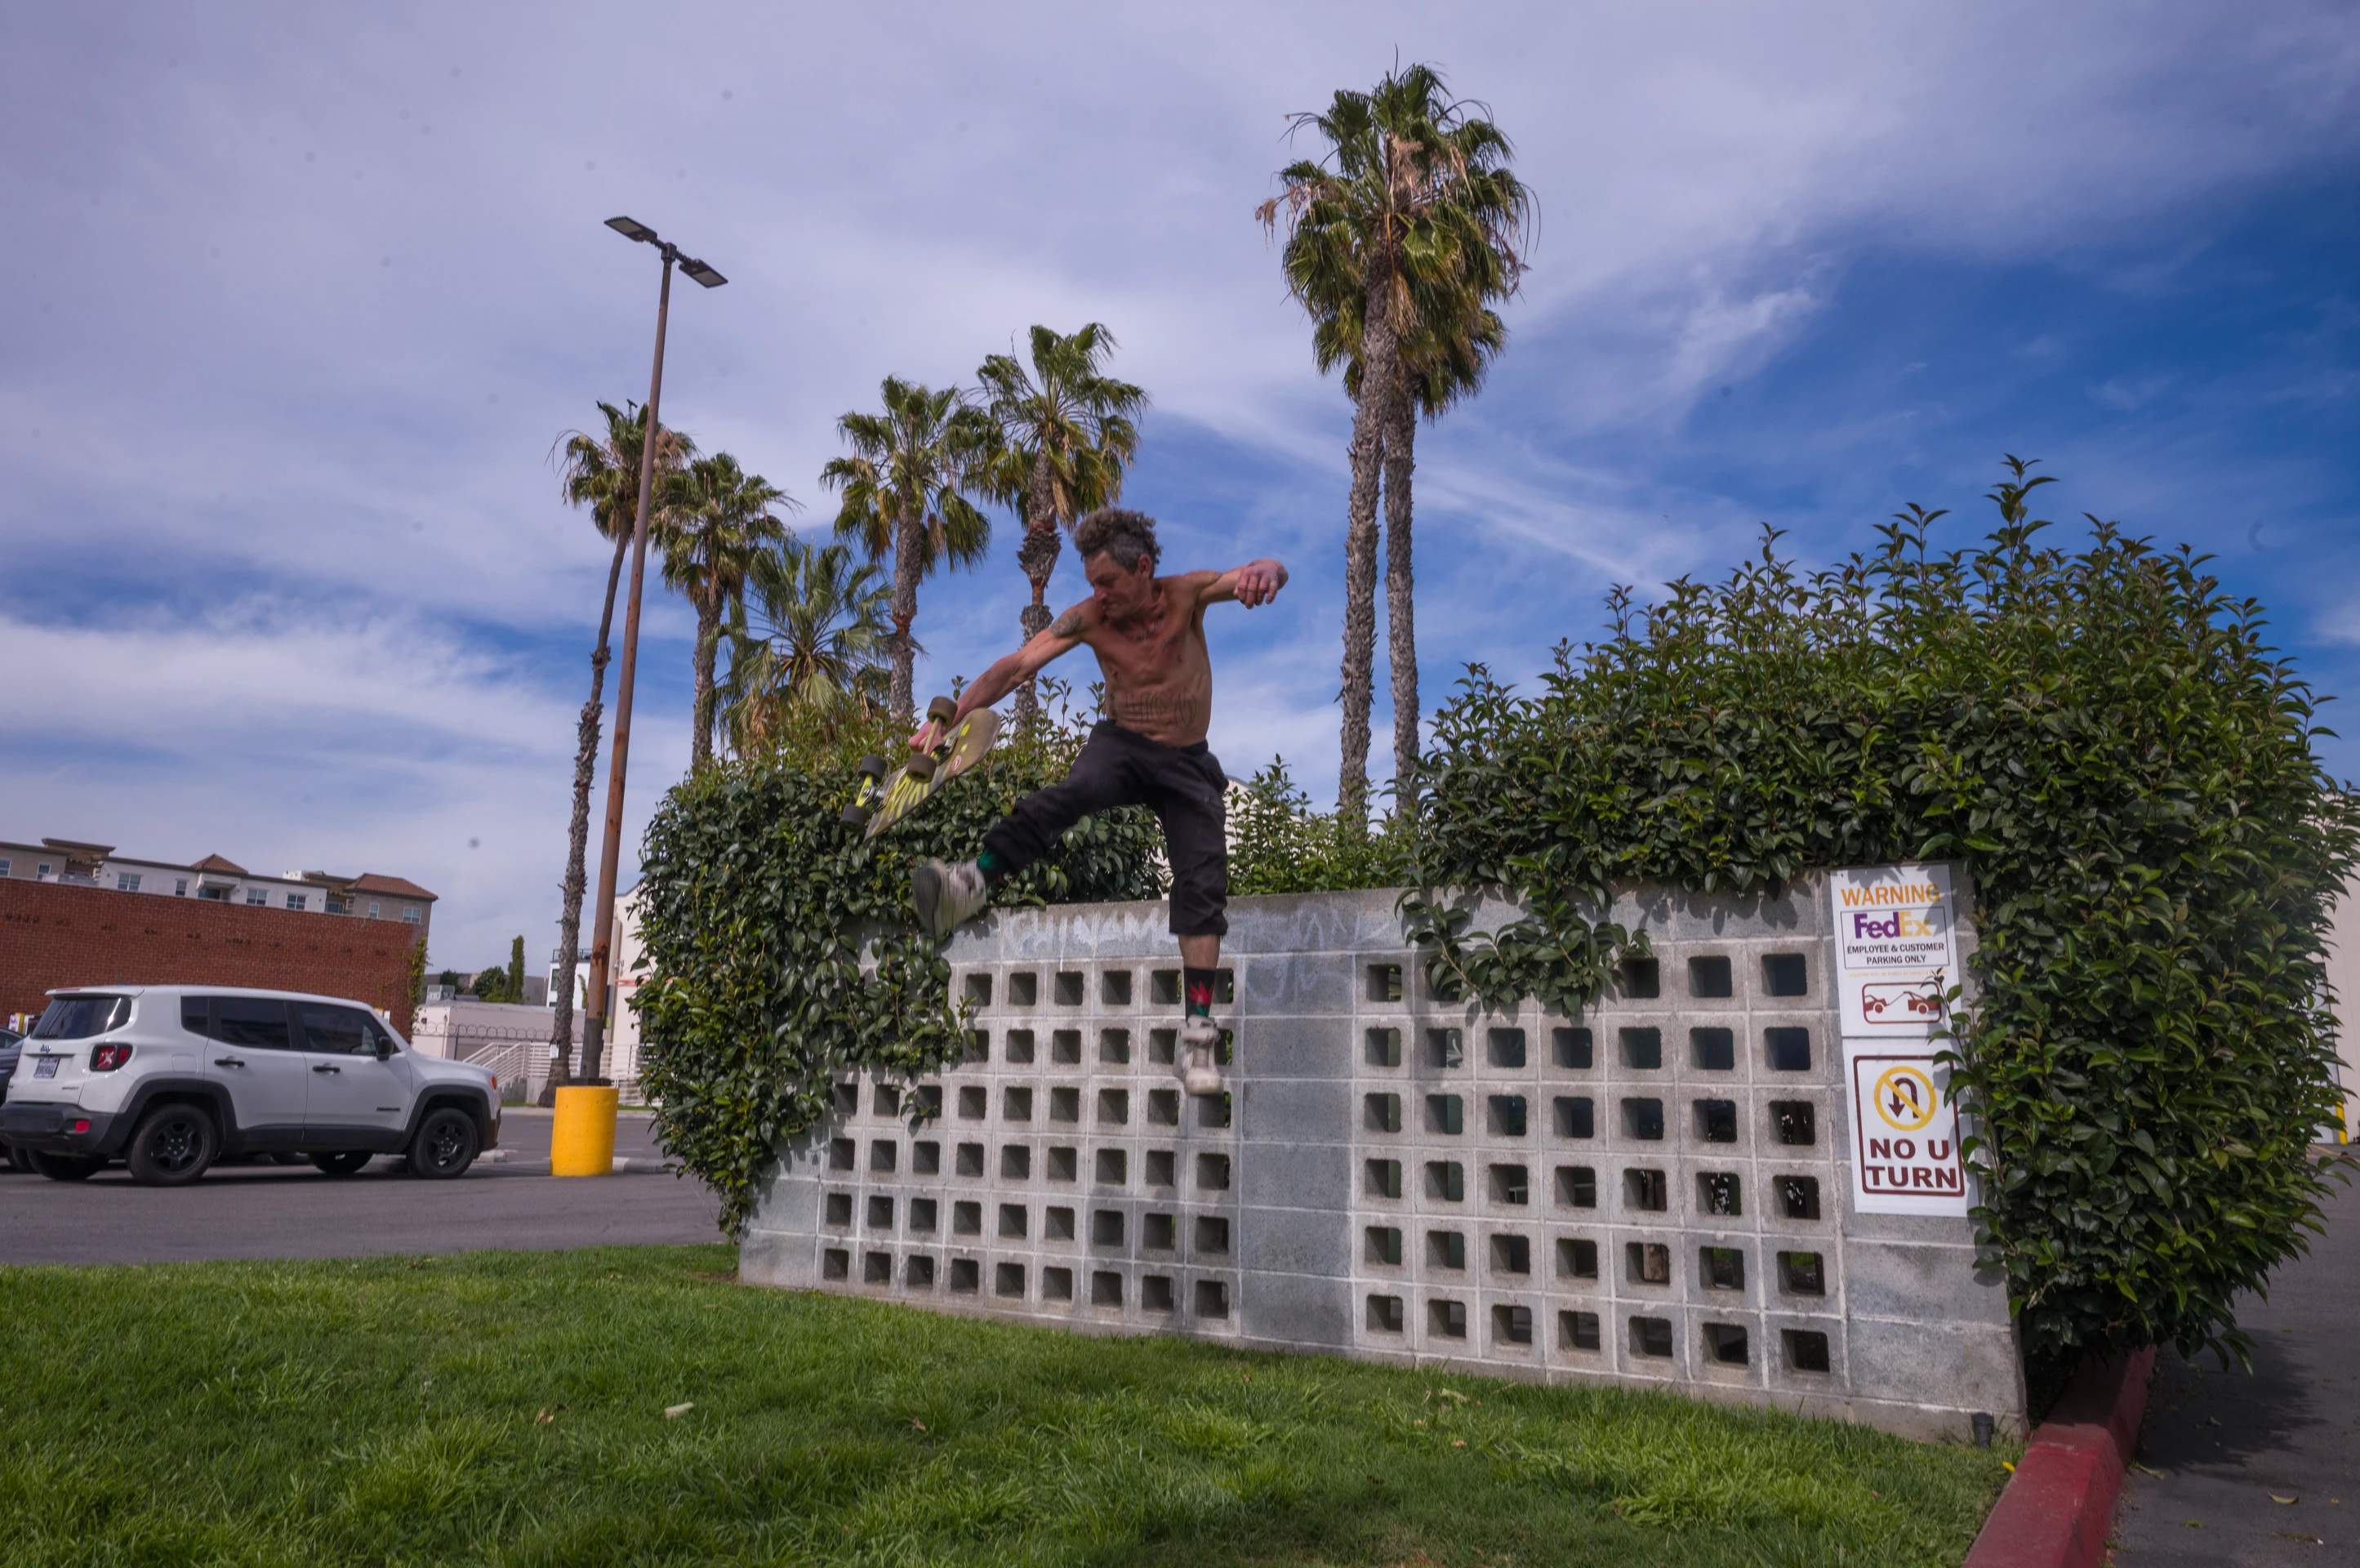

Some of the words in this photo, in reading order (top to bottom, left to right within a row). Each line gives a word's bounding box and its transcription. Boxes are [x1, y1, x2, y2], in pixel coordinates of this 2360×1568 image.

[1841, 883, 1941, 906] WARNING
[1854, 911, 1932, 938] FedEx
[1847, 944, 1890, 955] EMPLOYEE
[1891, 943, 1898, 952] &
[1899, 942, 1944, 952] CUSTOMER
[1867, 956, 1903, 964] PARKING
[1904, 955, 1926, 964] ONLY
[1869, 1138, 1916, 1160] NO
[1927, 1139, 1949, 1160] U
[1865, 1166, 1957, 1188] TURN
